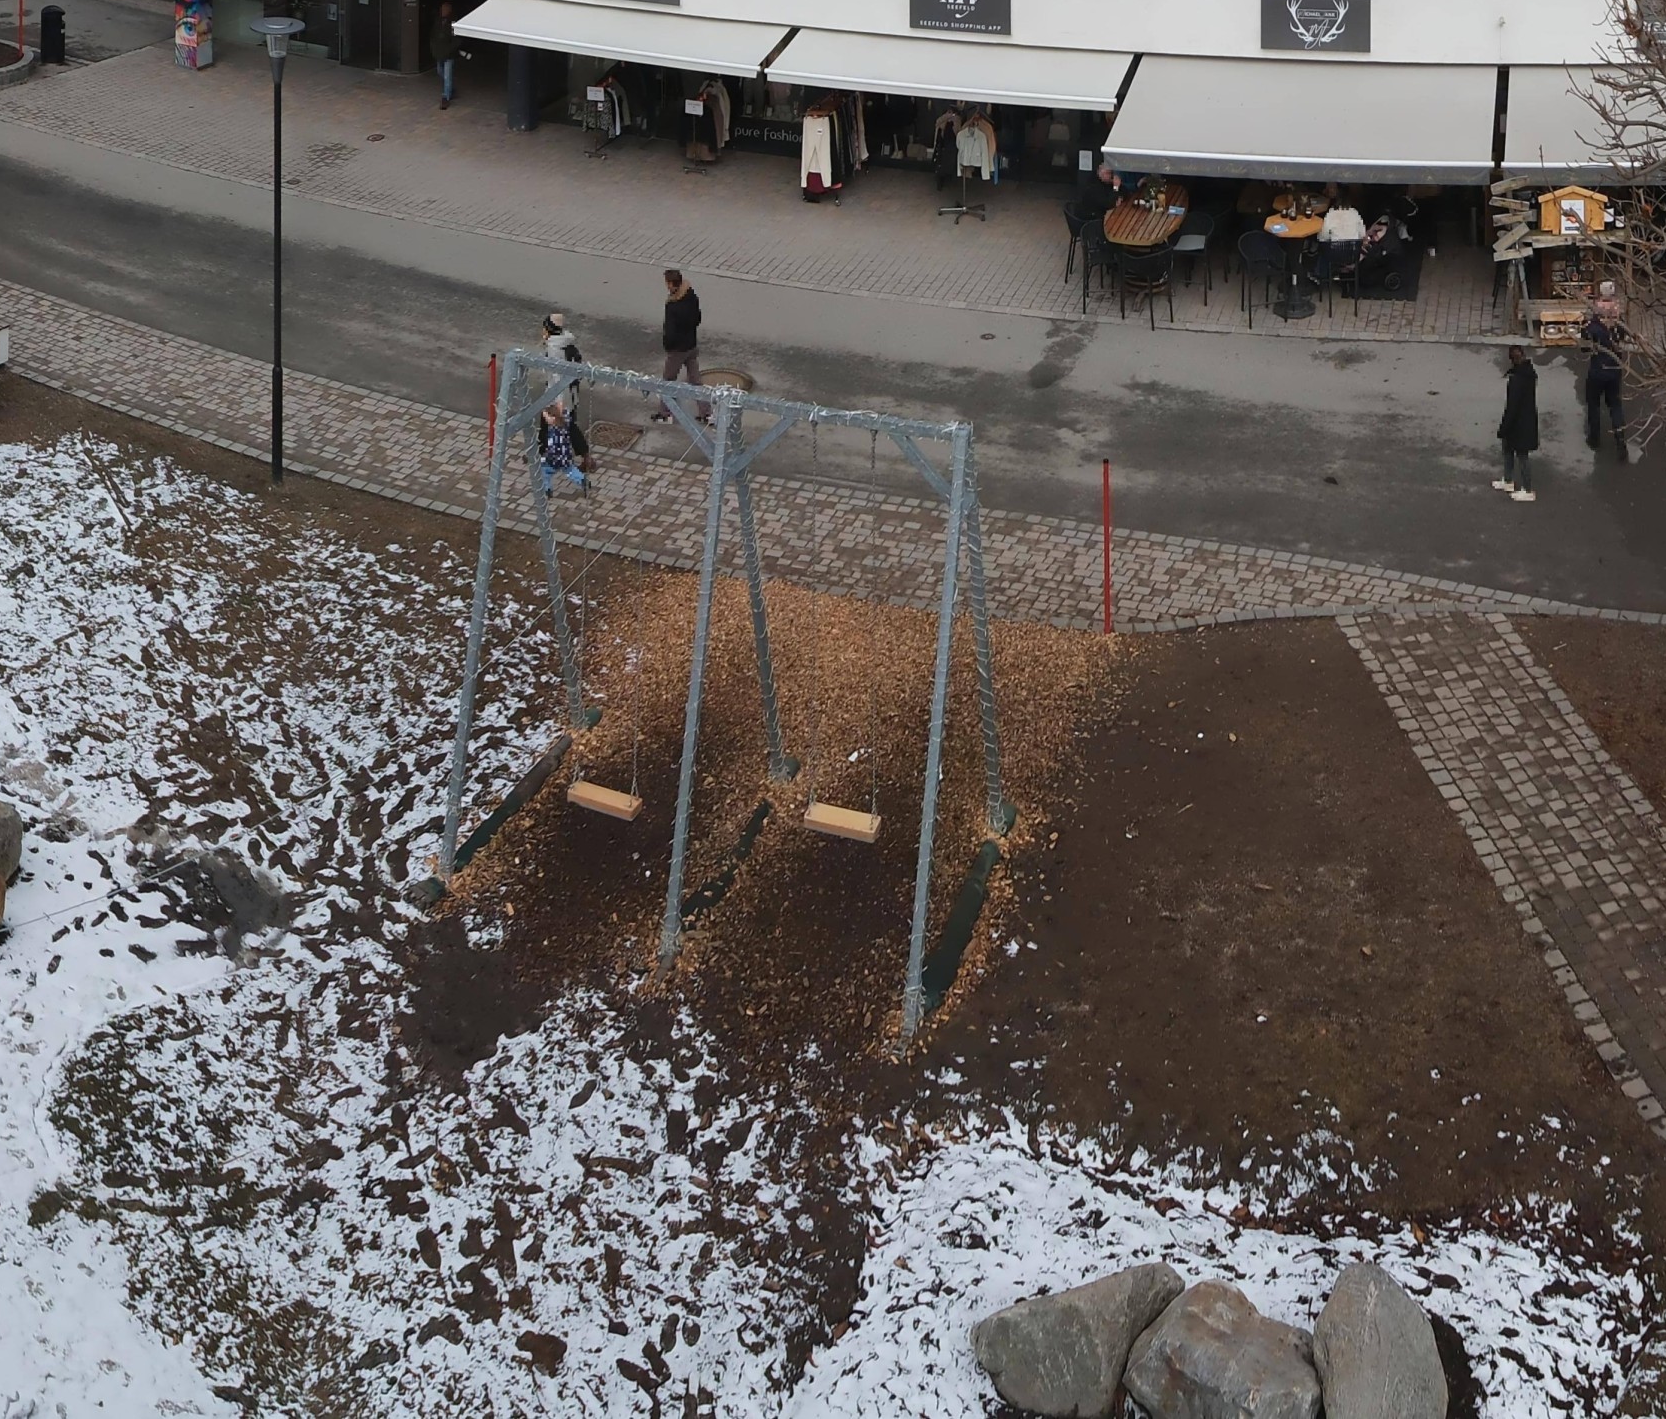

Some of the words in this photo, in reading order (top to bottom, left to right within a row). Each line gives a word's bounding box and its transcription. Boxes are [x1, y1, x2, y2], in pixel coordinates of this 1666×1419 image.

[920, 20, 948, 28] SEEFELD
[951, 22, 986, 30] SHOPPING
[734, 126, 760, 138] pure
